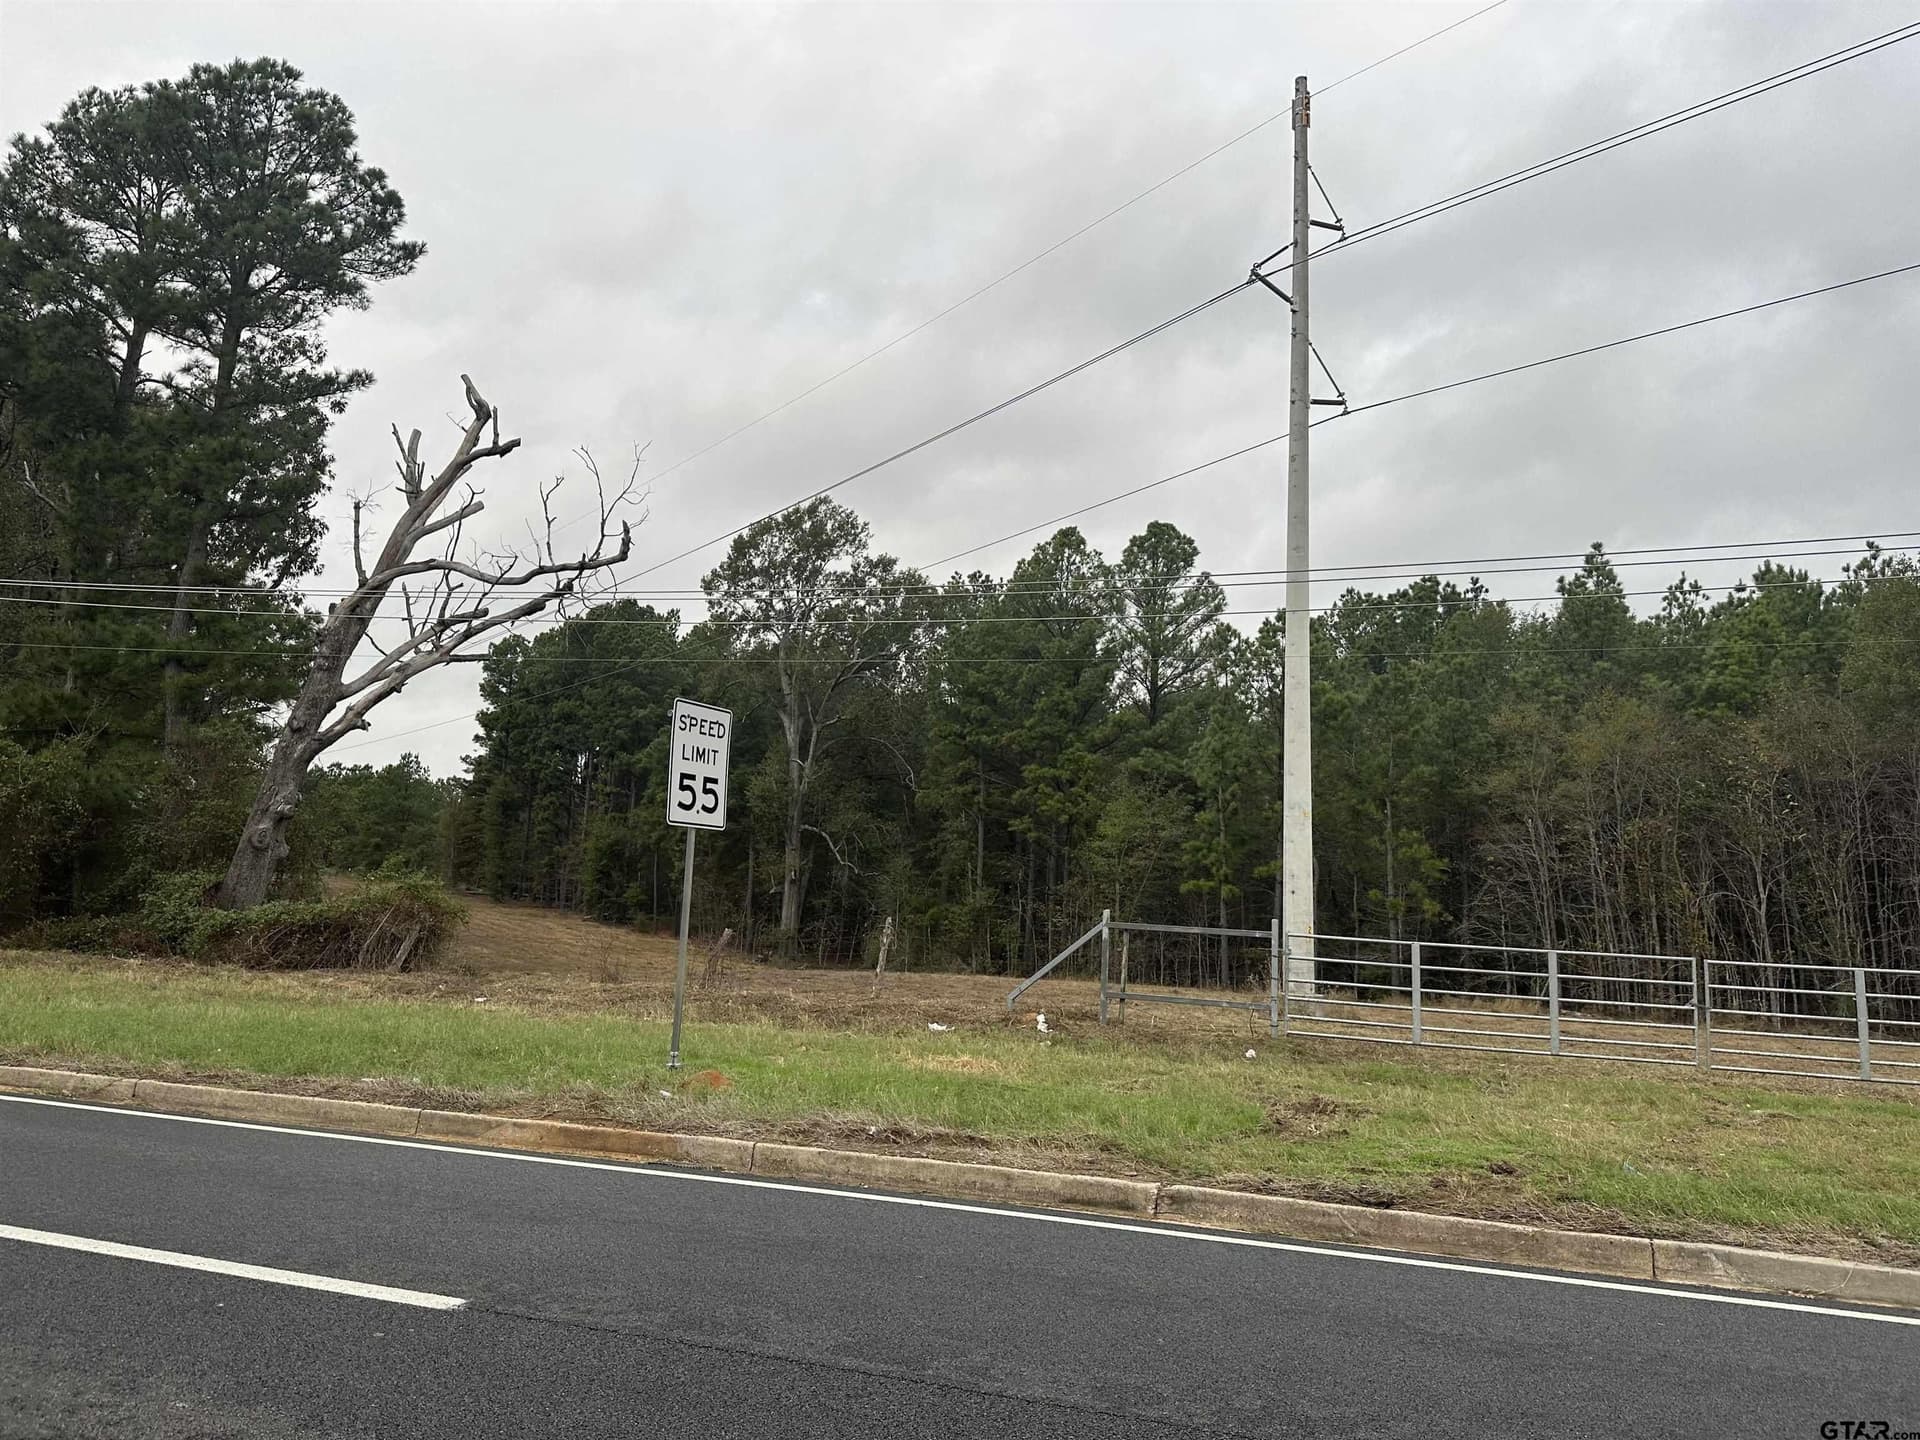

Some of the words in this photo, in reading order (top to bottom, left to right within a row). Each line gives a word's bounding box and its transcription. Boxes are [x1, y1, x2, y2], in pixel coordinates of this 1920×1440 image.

[679, 714, 726, 739] SPEED
[682, 743, 719, 766] LIMIT
[677, 772, 719, 815] 55
